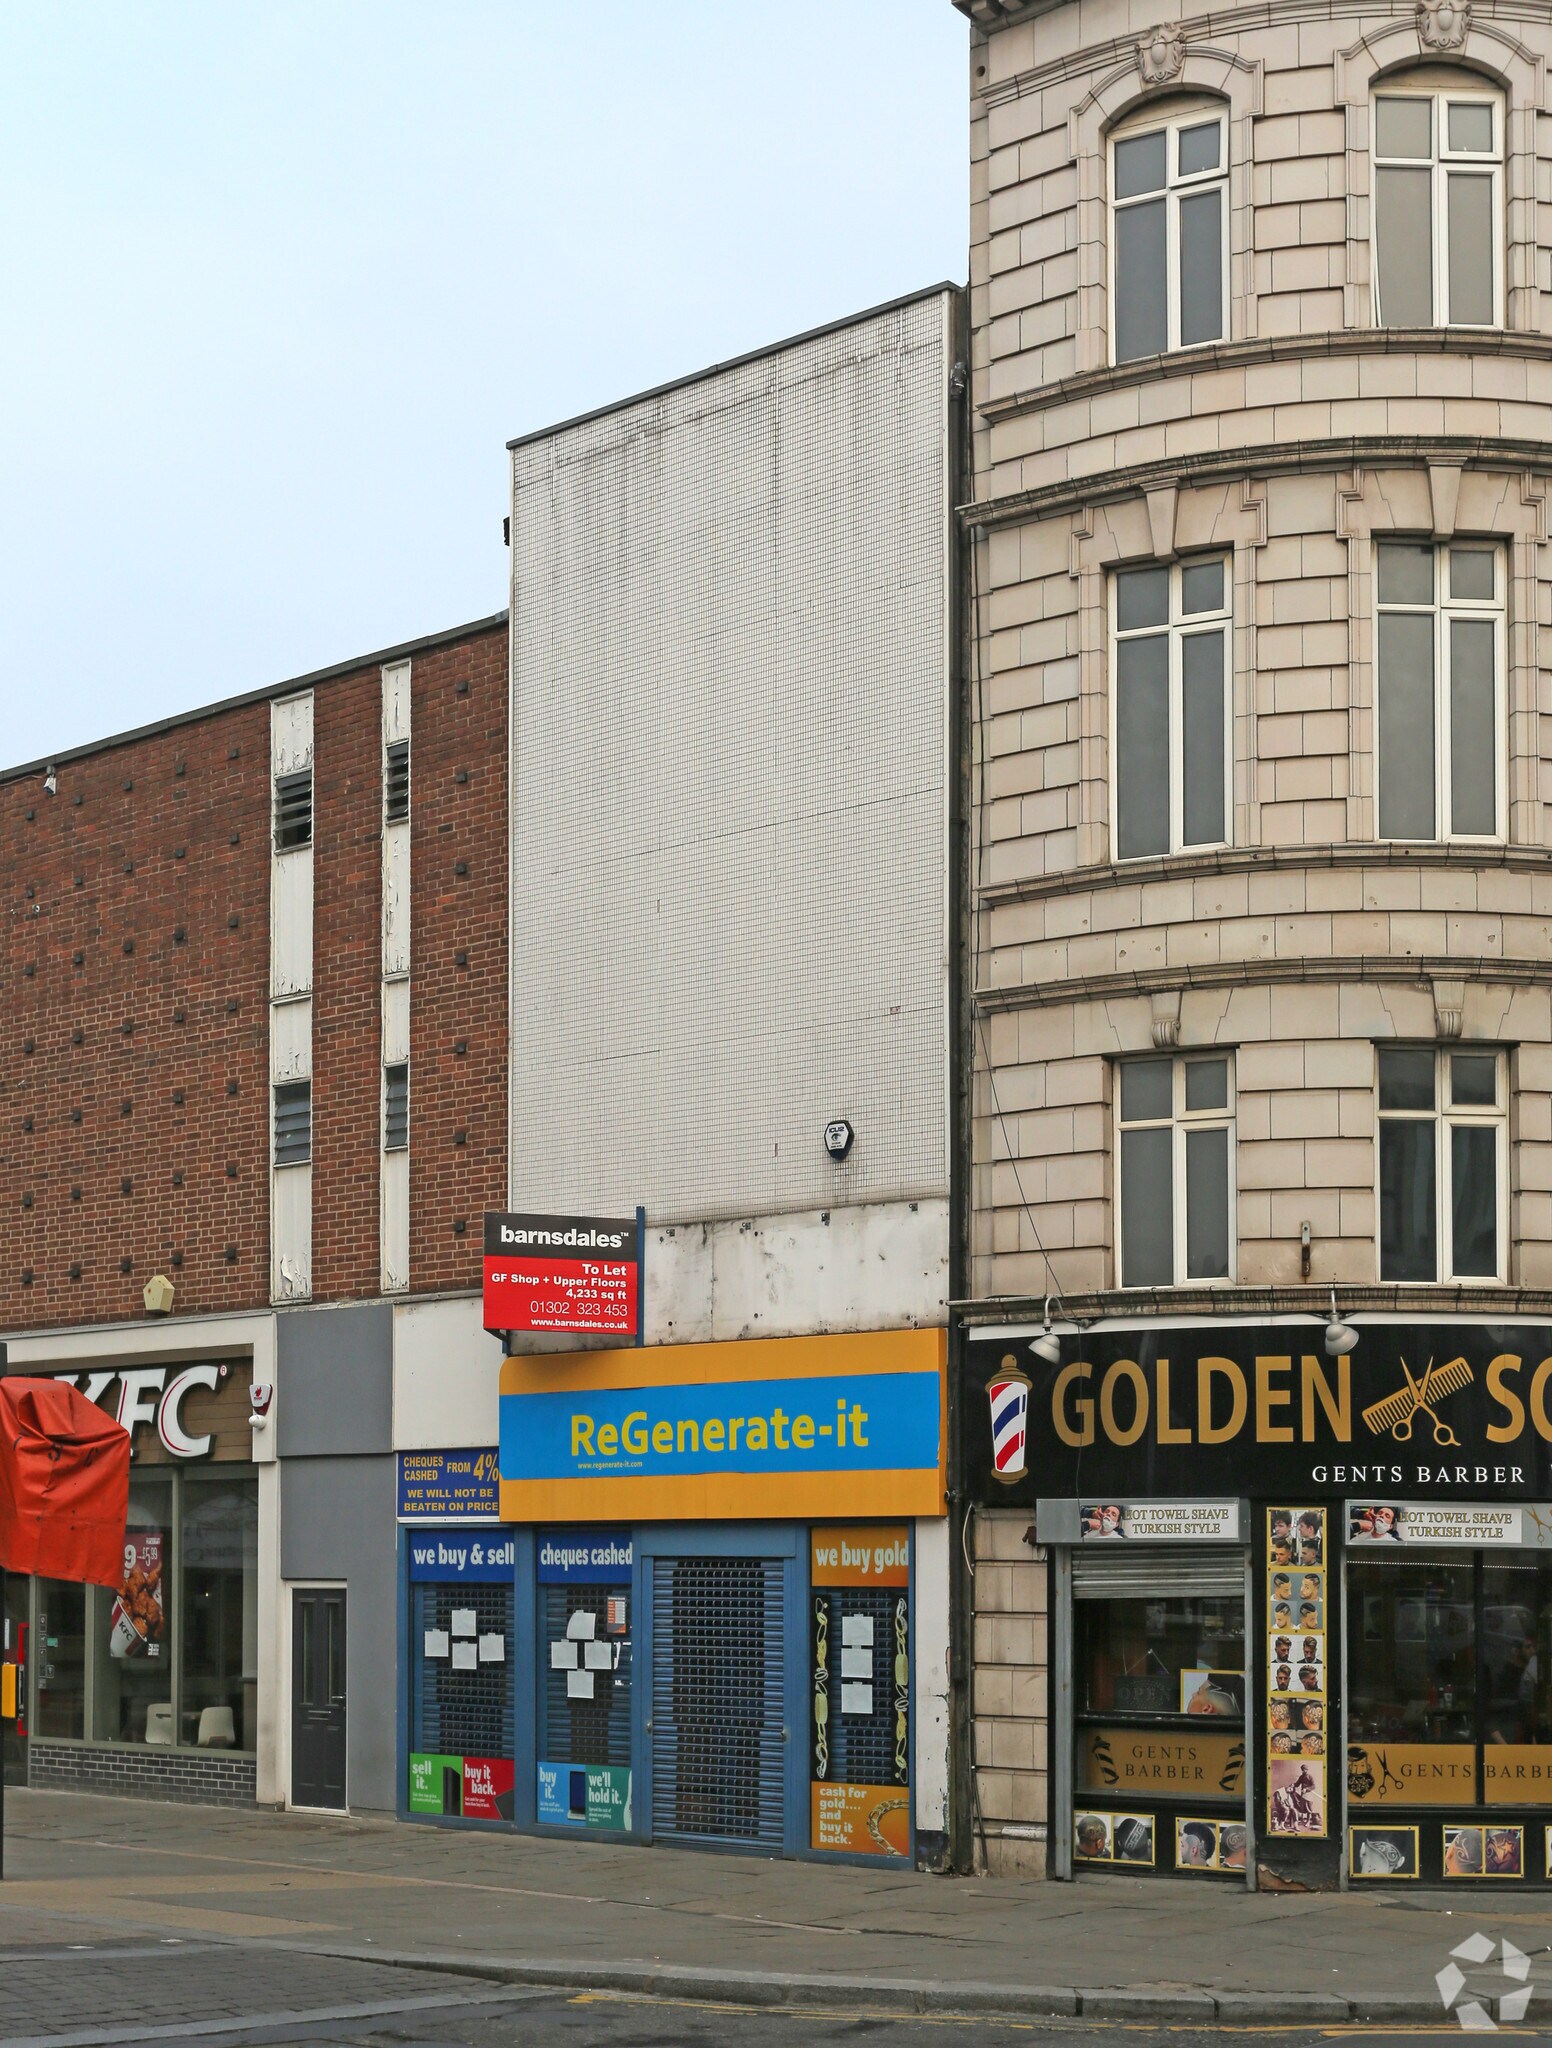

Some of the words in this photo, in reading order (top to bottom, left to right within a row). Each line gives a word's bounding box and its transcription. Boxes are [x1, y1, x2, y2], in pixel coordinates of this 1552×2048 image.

[582, 1264, 599, 1275] To
[604, 1265, 627, 1276] Let
[492, 1273, 507, 1282] GF
[511, 1274, 539, 1286] Shop
[553, 1276, 587, 1288] Upper
[591, 1278, 627, 1288] Floors
[566, 1289, 598, 1299] 4,233
[601, 1291, 614, 1301] sq
[617, 1290, 627, 1300] ft
[530, 1301, 570, 1314] 01302
[577, 1303, 601, 1315] 323
[604, 1304, 628, 1317] 453
[531, 1318, 628, 1329] www.barnsdales.co.uk
[1052, 1355, 1350, 1447] GOLDEN
[571, 1399, 868, 1457] ReGenerate-it
[403, 1456, 444, 1467] CHEQUES
[447, 1462, 471, 1473] FROM
[473, 1453, 499, 1482] 4%
[578, 1460, 643, 1470] www.regenerate-it.com
[404, 1470, 438, 1481] CASHED
[1312, 1465, 1403, 1483] GENTS
[1417, 1466, 1525, 1483] BARBER
[407, 1489, 423, 1498] WE
[426, 1489, 451, 1498] WILL
[454, 1489, 476, 1498] NOT
[479, 1489, 493, 1497] BE
[404, 1503, 446, 1512] BEATEN
[448, 1502, 464, 1511] ON
[467, 1502, 498, 1511] PRICE
[1124, 1509, 1148, 1520] HOT
[1150, 1509, 1190, 1520] TOWEL
[1191, 1509, 1229, 1520] SHAVE
[1399, 1512, 1426, 1523] HOT
[1427, 1512, 1470, 1523] TOWEL
[1472, 1513, 1512, 1524] SHAVE
[1132, 1523, 1182, 1534] TURKISH
[1184, 1523, 1221, 1534] STYLE
[1408, 1526, 1462, 1538] TURKISH
[1464, 1527, 1504, 1538] STYLE
[413, 1548, 436, 1565] we
[438, 1542, 467, 1571] buy
[470, 1543, 484, 1565] &
[487, 1542, 515, 1565] sell
[540, 1542, 588, 1571] cheques
[591, 1542, 632, 1565] cashed
[815, 1548, 838, 1566] we
[842, 1540, 871, 1574] buy
[874, 1540, 909, 1574] gold
[118, 1620, 132, 1641] KFC
[1132, 1745, 1197, 1761] GENTS
[412, 1760, 432, 1775] sell
[465, 1763, 482, 1783] buy
[483, 1764, 491, 1780] it
[1125, 1764, 1204, 1780] BARBER
[1400, 1763, 1472, 1778] GENTS
[416, 1775, 428, 1790] it.
[540, 1767, 557, 1787] buy
[588, 1771, 611, 1787] we'll
[471, 1779, 496, 1795] back.
[544, 1783, 555, 1799] it.
[820, 1787, 846, 1797] cash
[848, 1787, 867, 1799] for
[588, 1787, 609, 1804] hold
[611, 1788, 622, 1805] it.
[820, 1810, 841, 1820] and
[820, 1821, 841, 1834] buy
[843, 1822, 853, 1833] it
[820, 1832, 852, 1845] back.
